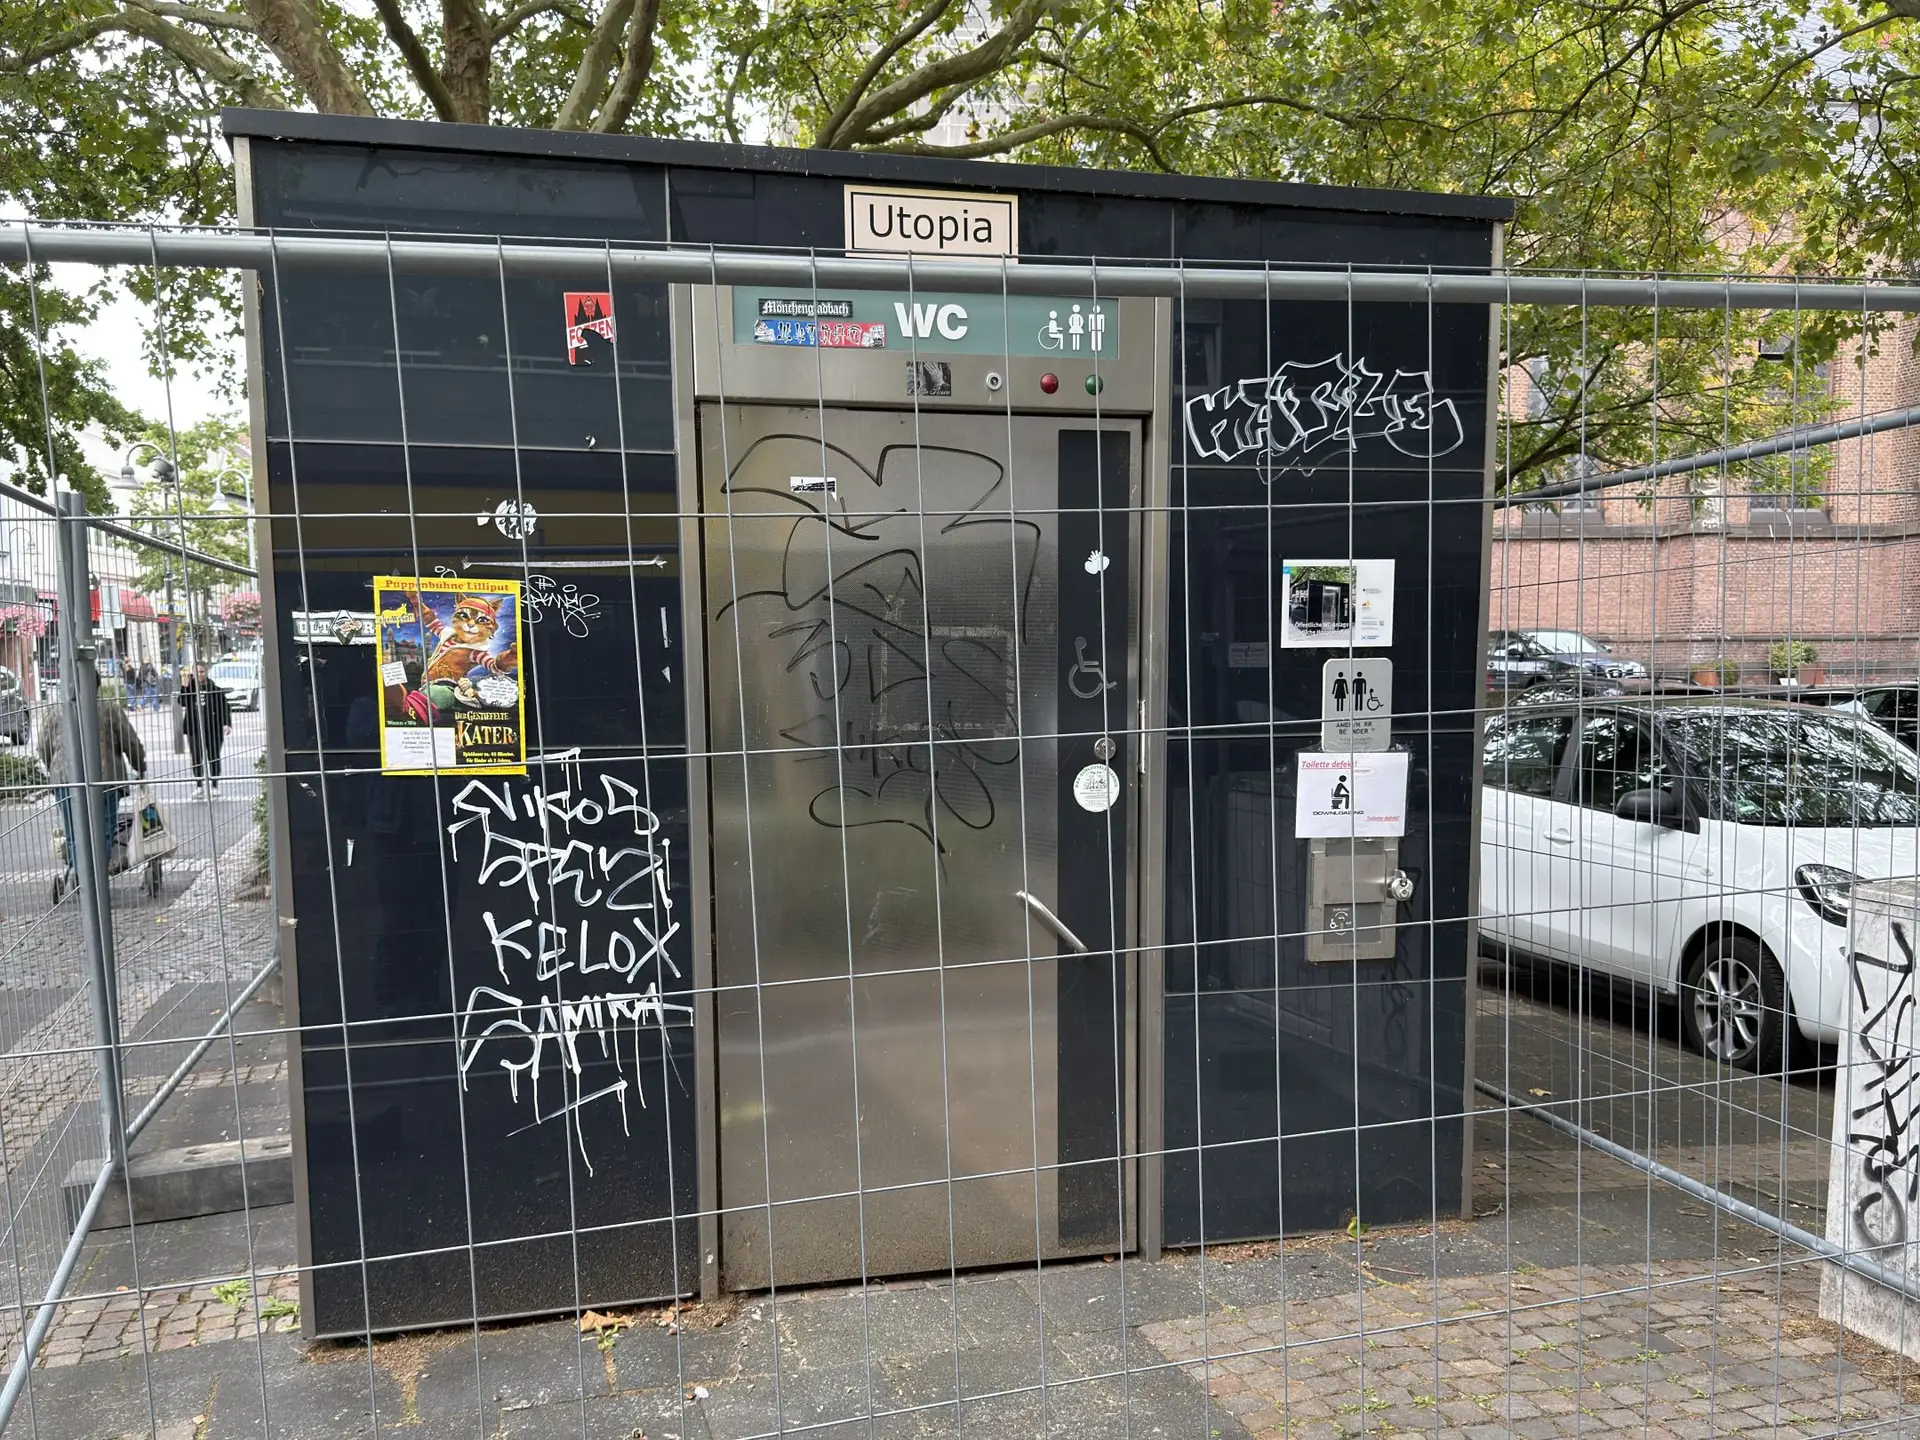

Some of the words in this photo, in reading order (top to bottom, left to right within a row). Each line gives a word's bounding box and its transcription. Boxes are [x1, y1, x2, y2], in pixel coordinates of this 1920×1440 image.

[869, 203, 993, 249] Utopia
[762, 300, 849, 316] Mönchengadbach
[893, 301, 968, 340] WC
[467, 581, 509, 592] Lilliput
[455, 720, 514, 748] KATER
[1301, 760, 1330, 768] Toilette
[1331, 760, 1358, 768] defek!
[482, 911, 681, 984] KELOX
